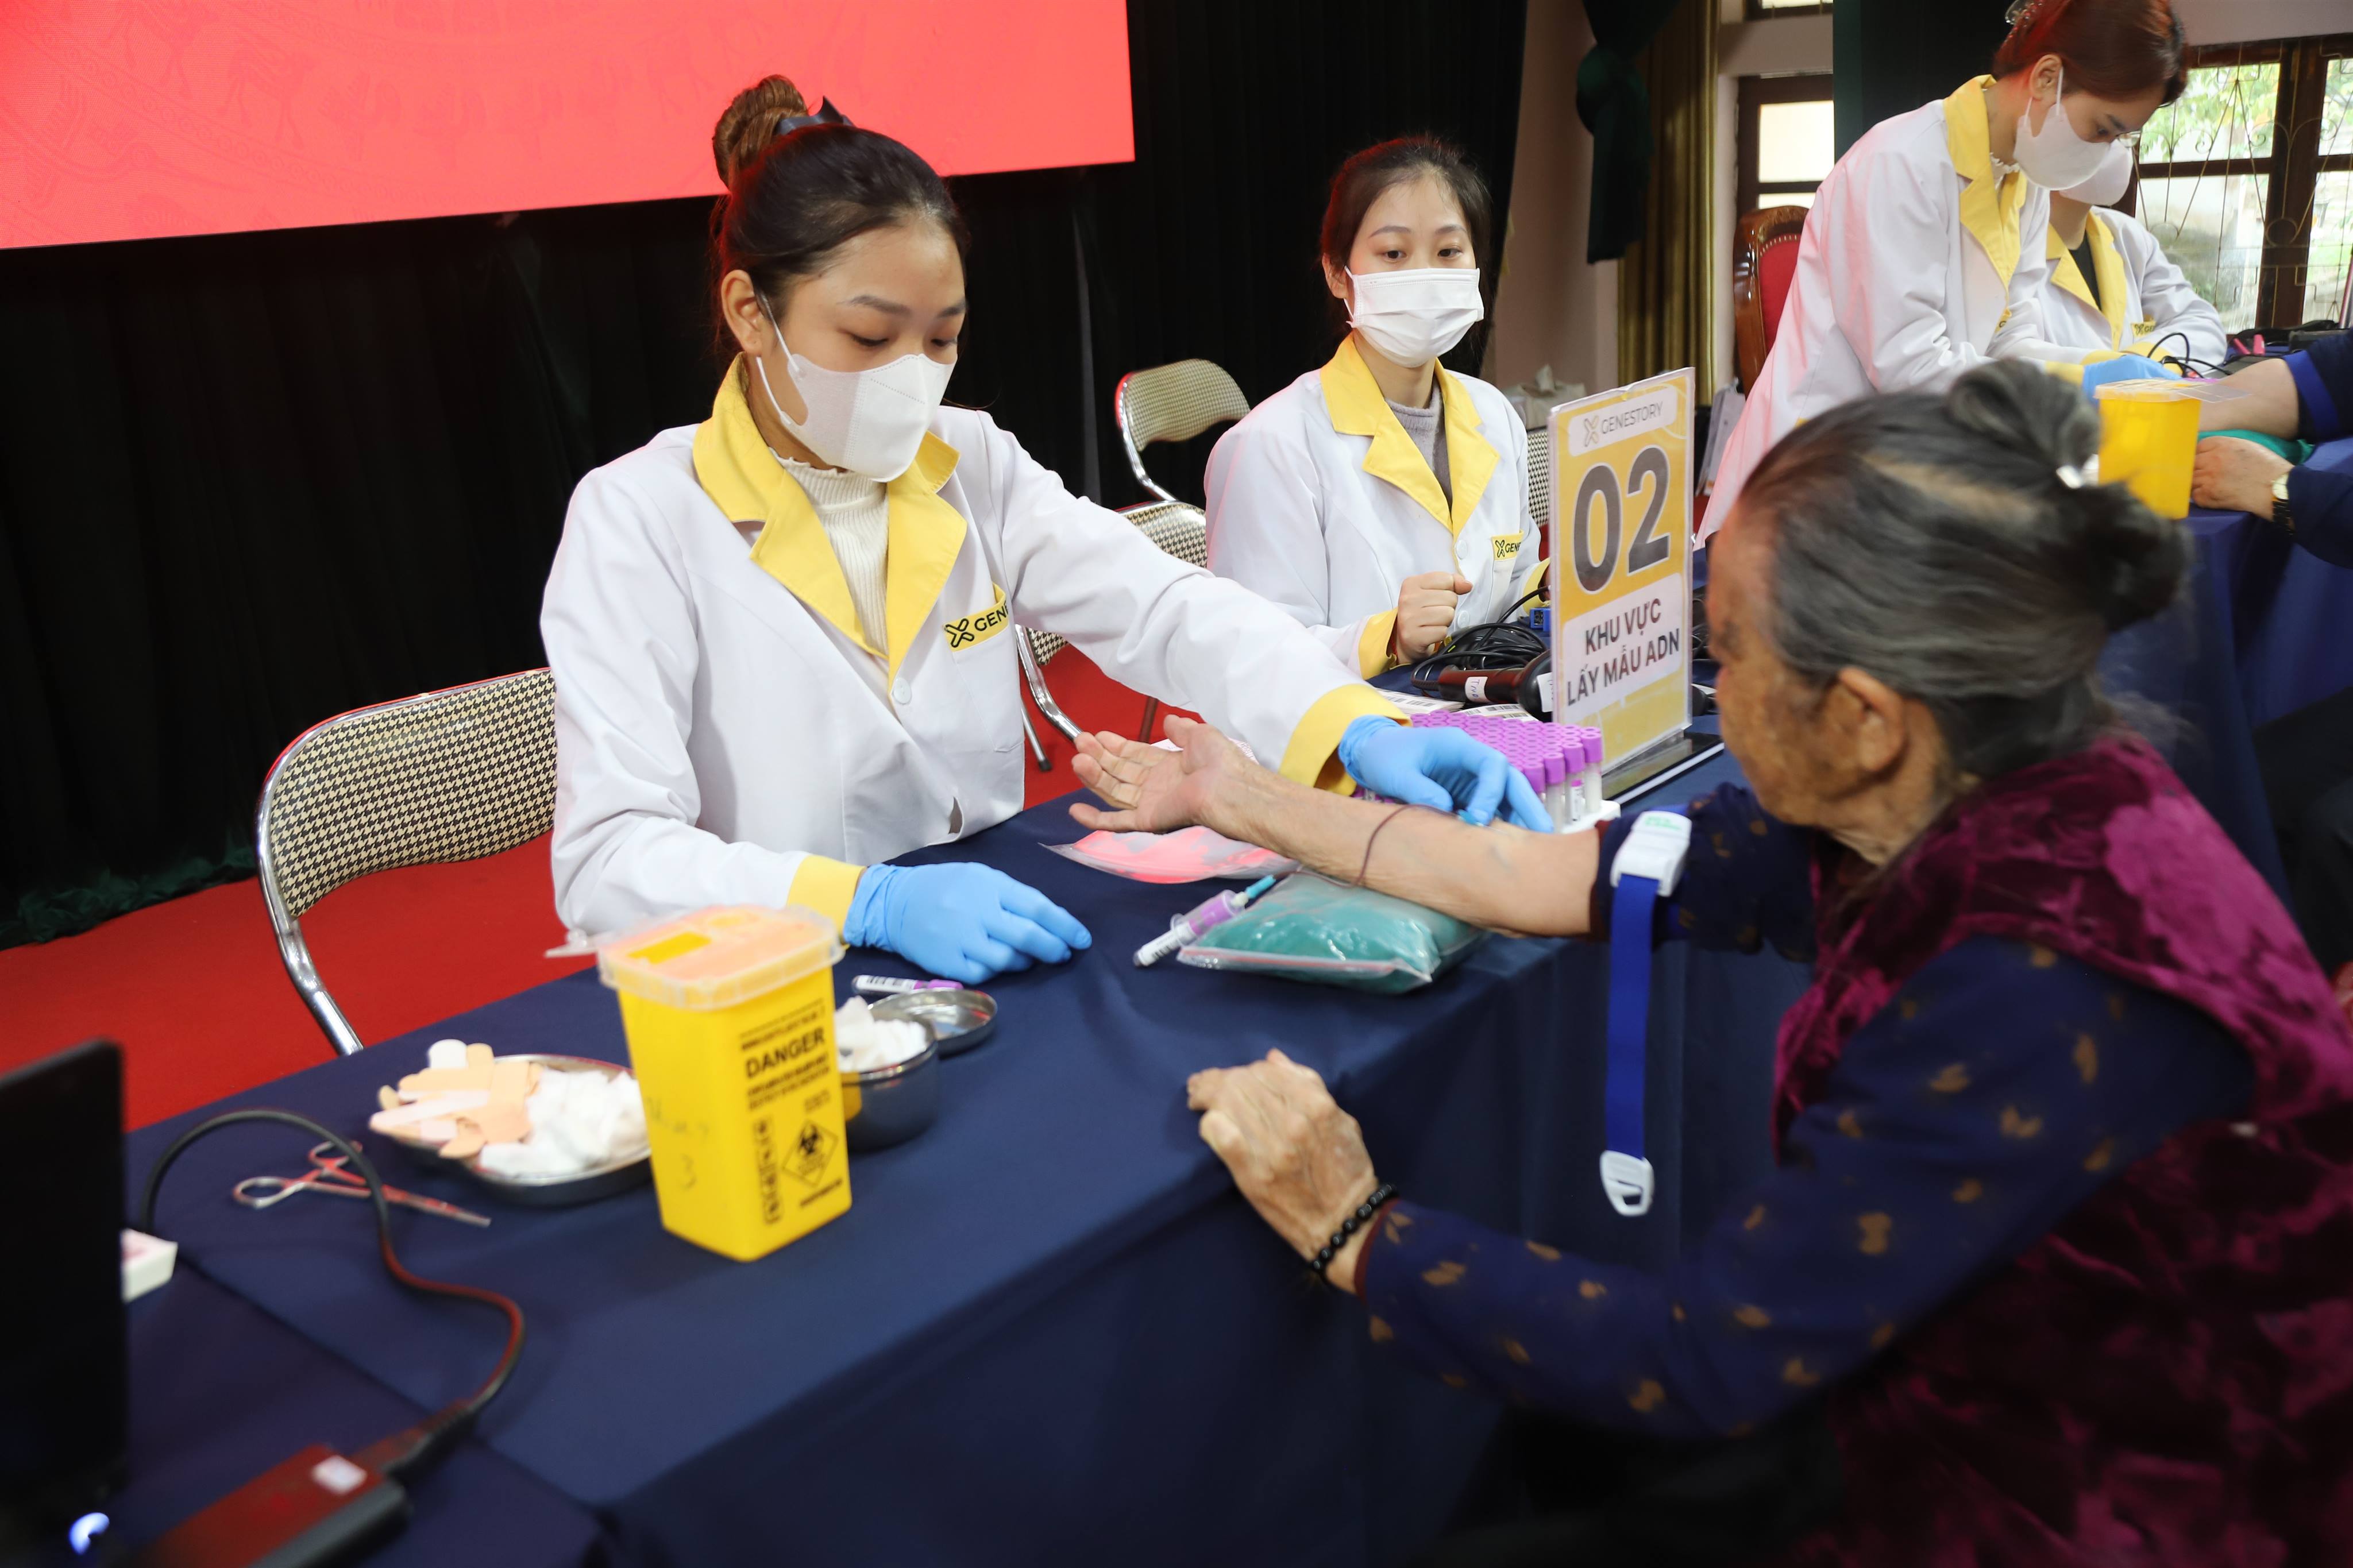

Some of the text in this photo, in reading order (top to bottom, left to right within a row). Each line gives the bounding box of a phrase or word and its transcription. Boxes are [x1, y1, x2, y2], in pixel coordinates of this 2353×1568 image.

[1601, 401, 1663, 434] GENESTORY
[1573, 446, 1670, 593] 02
[1586, 598, 1661, 655] KHU VỰC
[1568, 664, 1599, 706] LẤY
[1604, 644, 1641, 688] MẪU
[1646, 628, 1679, 666] ADN
[746, 1026, 825, 1079] DANGER
